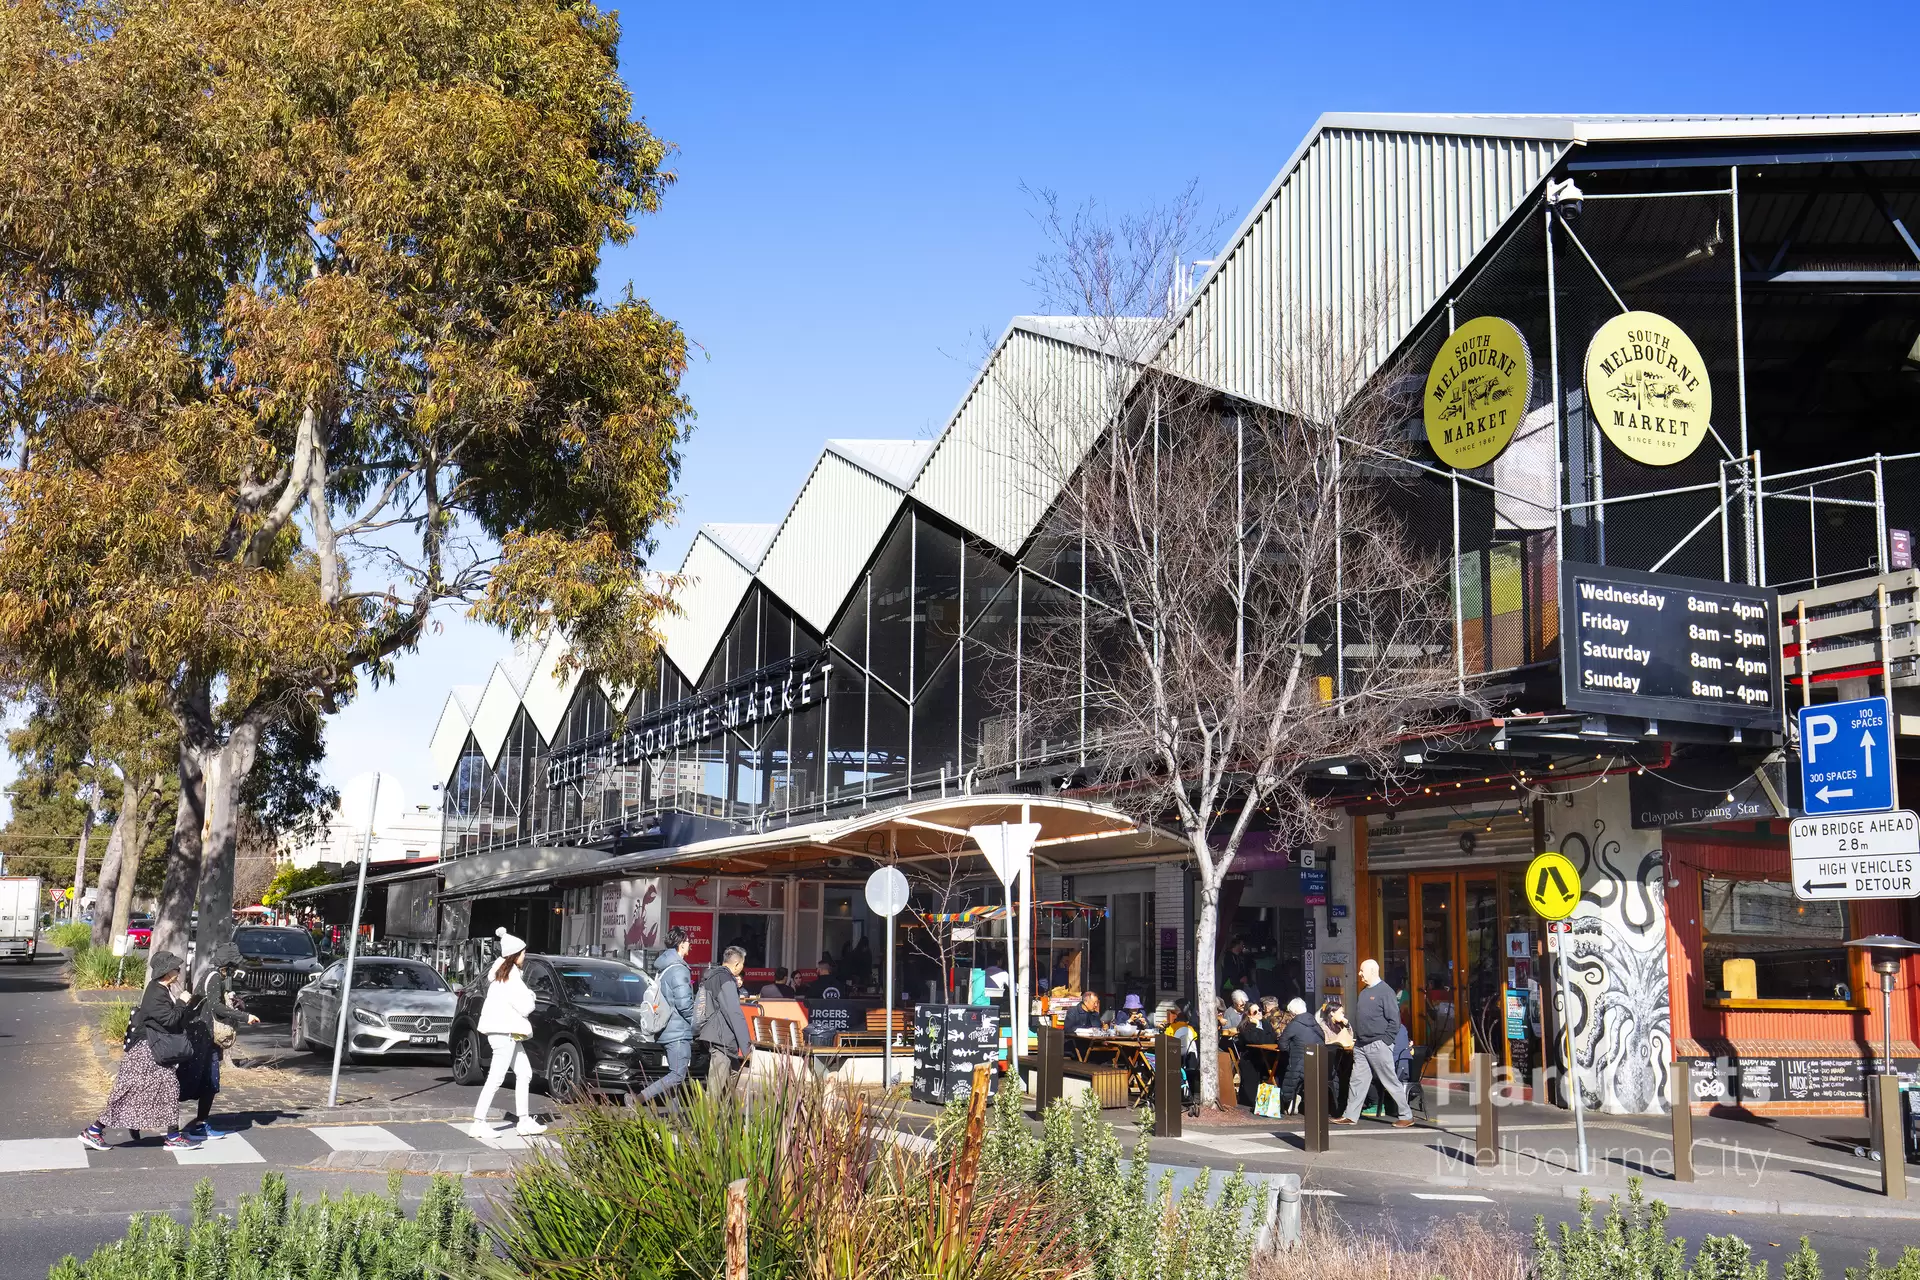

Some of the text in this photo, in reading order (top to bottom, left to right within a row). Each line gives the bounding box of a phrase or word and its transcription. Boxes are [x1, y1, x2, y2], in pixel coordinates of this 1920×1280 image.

[1454, 334, 1491, 358] SOUTH
[1627, 329, 1670, 350] SOUTH
[1432, 349, 1517, 403] MELBOURNE
[1599, 344, 1700, 392] MELBOURNE
[1443, 409, 1507, 445] MARKET
[1613, 410, 1689, 437] MARKET
[1455, 435, 1497, 455] SINCE 1867
[1627, 435, 1677, 449] SINCE 1867
[1580, 583, 1665, 611] Wednesday
[1687, 596, 1719, 614] 8am
[1732, 602, 1764, 620] 4pm
[1582, 612, 1629, 635] Friday
[1689, 624, 1720, 642] 8am
[1734, 630, 1766, 648] 5pm
[1583, 640, 1650, 666] Saturday
[1690, 652, 1721, 670] 8am
[1735, 657, 1767, 676] 4pm
[1584, 669, 1640, 693] Sunday
[1692, 680, 1723, 698] 8am
[1736, 685, 1769, 704] 4pm
[1851, 716, 1883, 729] SPACES
[1859, 708, 1873, 719] 100
[545, 664, 832, 788] SOUTH MELBOURNE MARKET
[1805, 714, 1838, 764] P
[1809, 770, 1857, 783] 300 SPACES
[1641, 803, 1760, 824] Claypots Evening Star
[1794, 818, 1914, 838] LOW BRIDGE AHEAD
[1304, 855, 1313, 866] G
[1819, 859, 1913, 876] HIGH VEHICLES
[1855, 877, 1912, 892] DETOUR
[1739, 1059, 1759, 1067] HAPPY
[1787, 1060, 1807, 1074] LIVE
[1789, 1075, 1809, 1090] MUSIC
